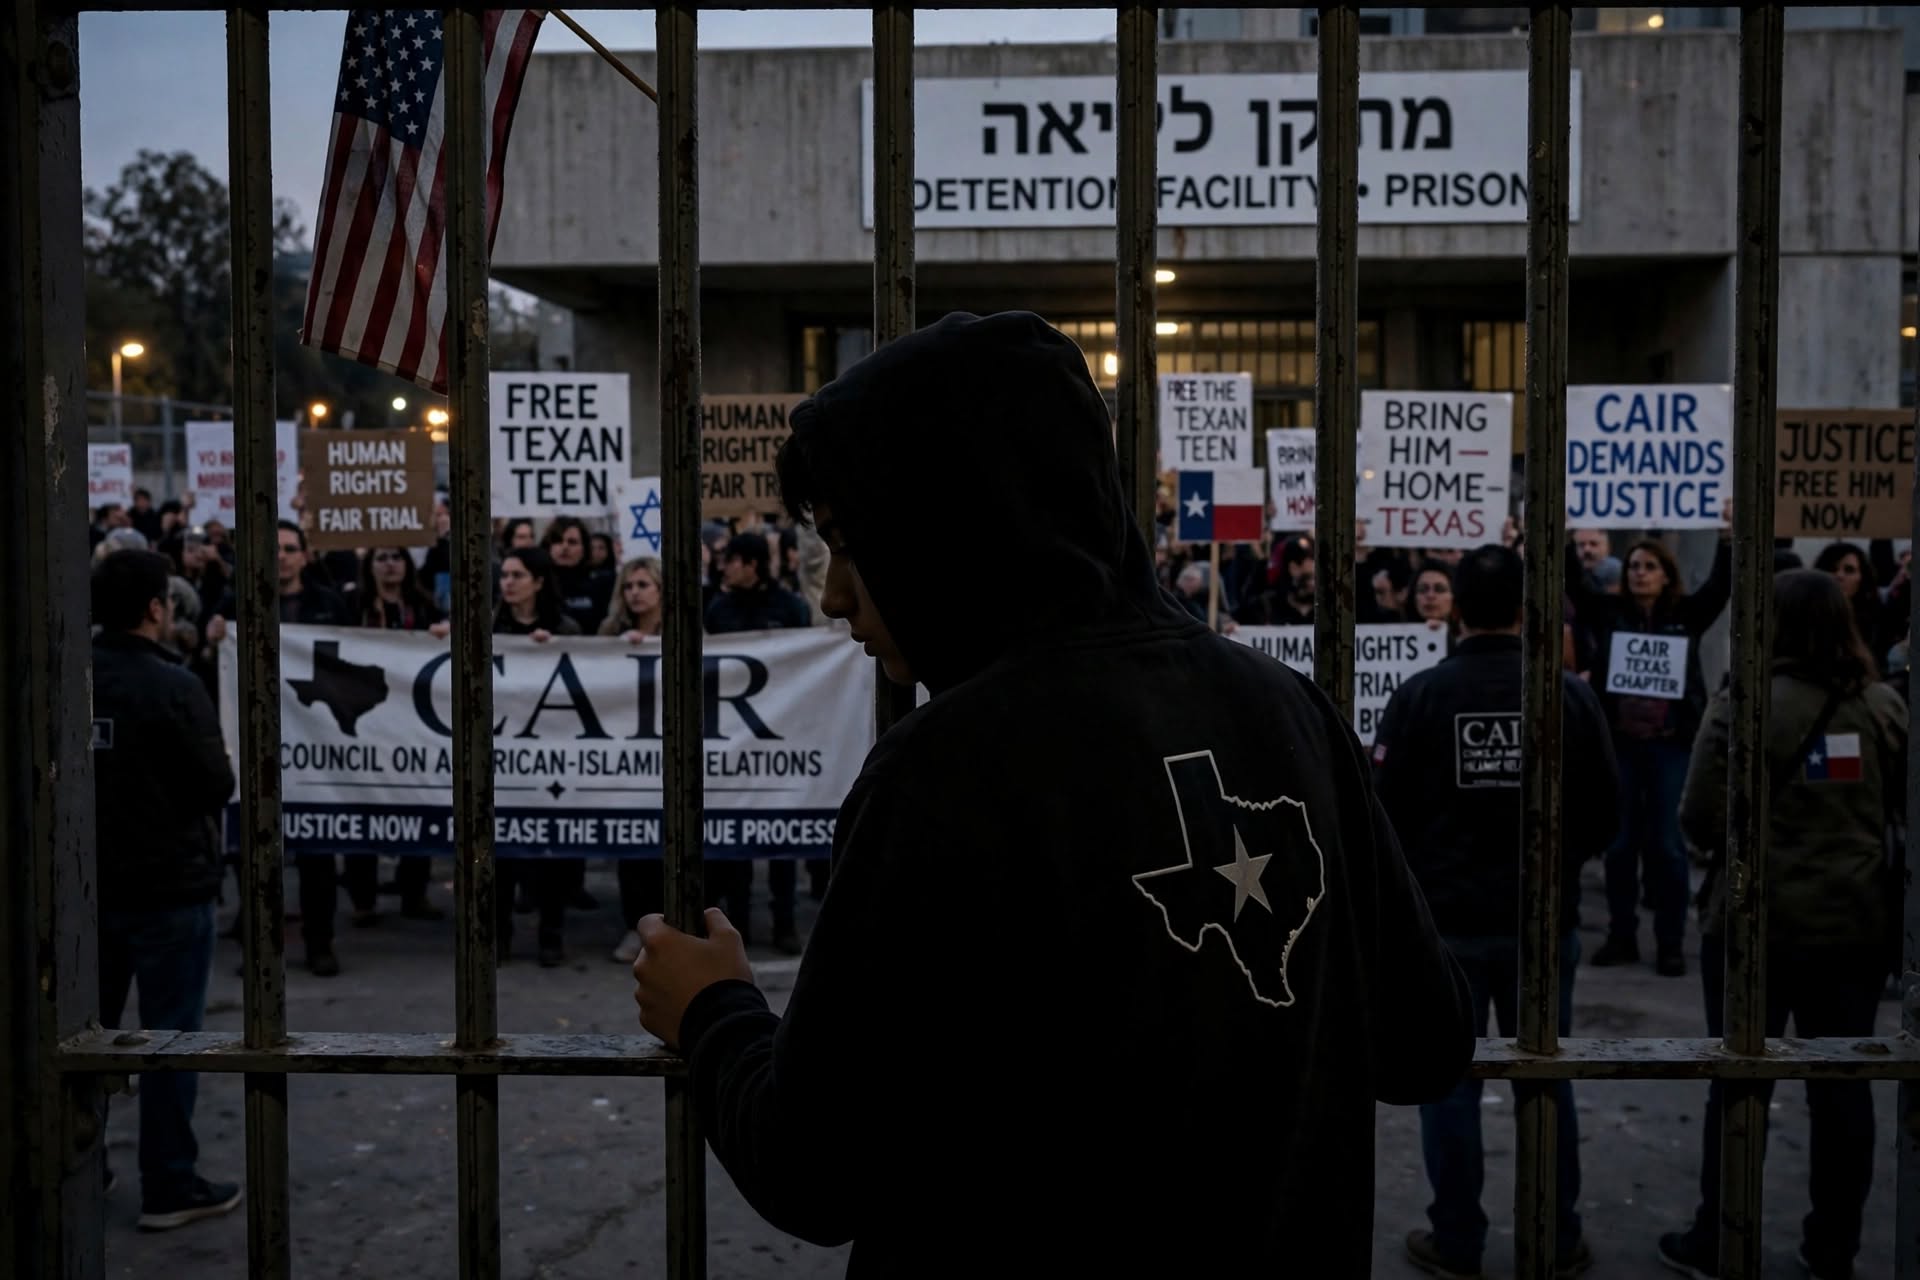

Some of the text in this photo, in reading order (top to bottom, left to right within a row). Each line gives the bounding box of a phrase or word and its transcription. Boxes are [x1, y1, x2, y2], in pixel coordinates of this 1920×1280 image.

[983, 85, 1213, 154] ליאה
[913, 176, 1118, 211] DETENTIO
[507, 384, 598, 419] FREE
[1203, 380, 1237, 402] THE
[702, 402, 787, 431] HUMAN
[1174, 405, 1247, 432] TEXAN
[1384, 400, 1487, 431] BRING
[1595, 394, 1697, 433] CAIR
[327, 440, 406, 467] HUMAN
[500, 426, 623, 462] TEXAN
[1176, 434, 1237, 463] TEEN
[1568, 441, 1725, 475] DEMANDS
[1779, 423, 1916, 463] JUSTICE
[329, 470, 408, 495] RIGHTS
[511, 468, 608, 505] TEEN
[1779, 469, 1895, 499] FREE HIM
[1568, 482, 1720, 518] JUSTICE
[318, 506, 423, 533] FAIR TRIAL
[1378, 508, 1485, 538] TEXAS
[1800, 502, 1866, 532] NOW
[1356, 635, 1418, 661] IGHTS
[1627, 638, 1670, 658] CAIR
[1624, 656, 1671, 675] TEXAS
[412, 651, 785, 740] CAIR
[1612, 673, 1679, 694] CHAPTER
[393, 746, 427, 774] ON
[706, 750, 823, 777] ELATIONS
[368, 813, 423, 842] NOW
[555, 818, 600, 845] THE
[603, 818, 661, 846] TEEN
